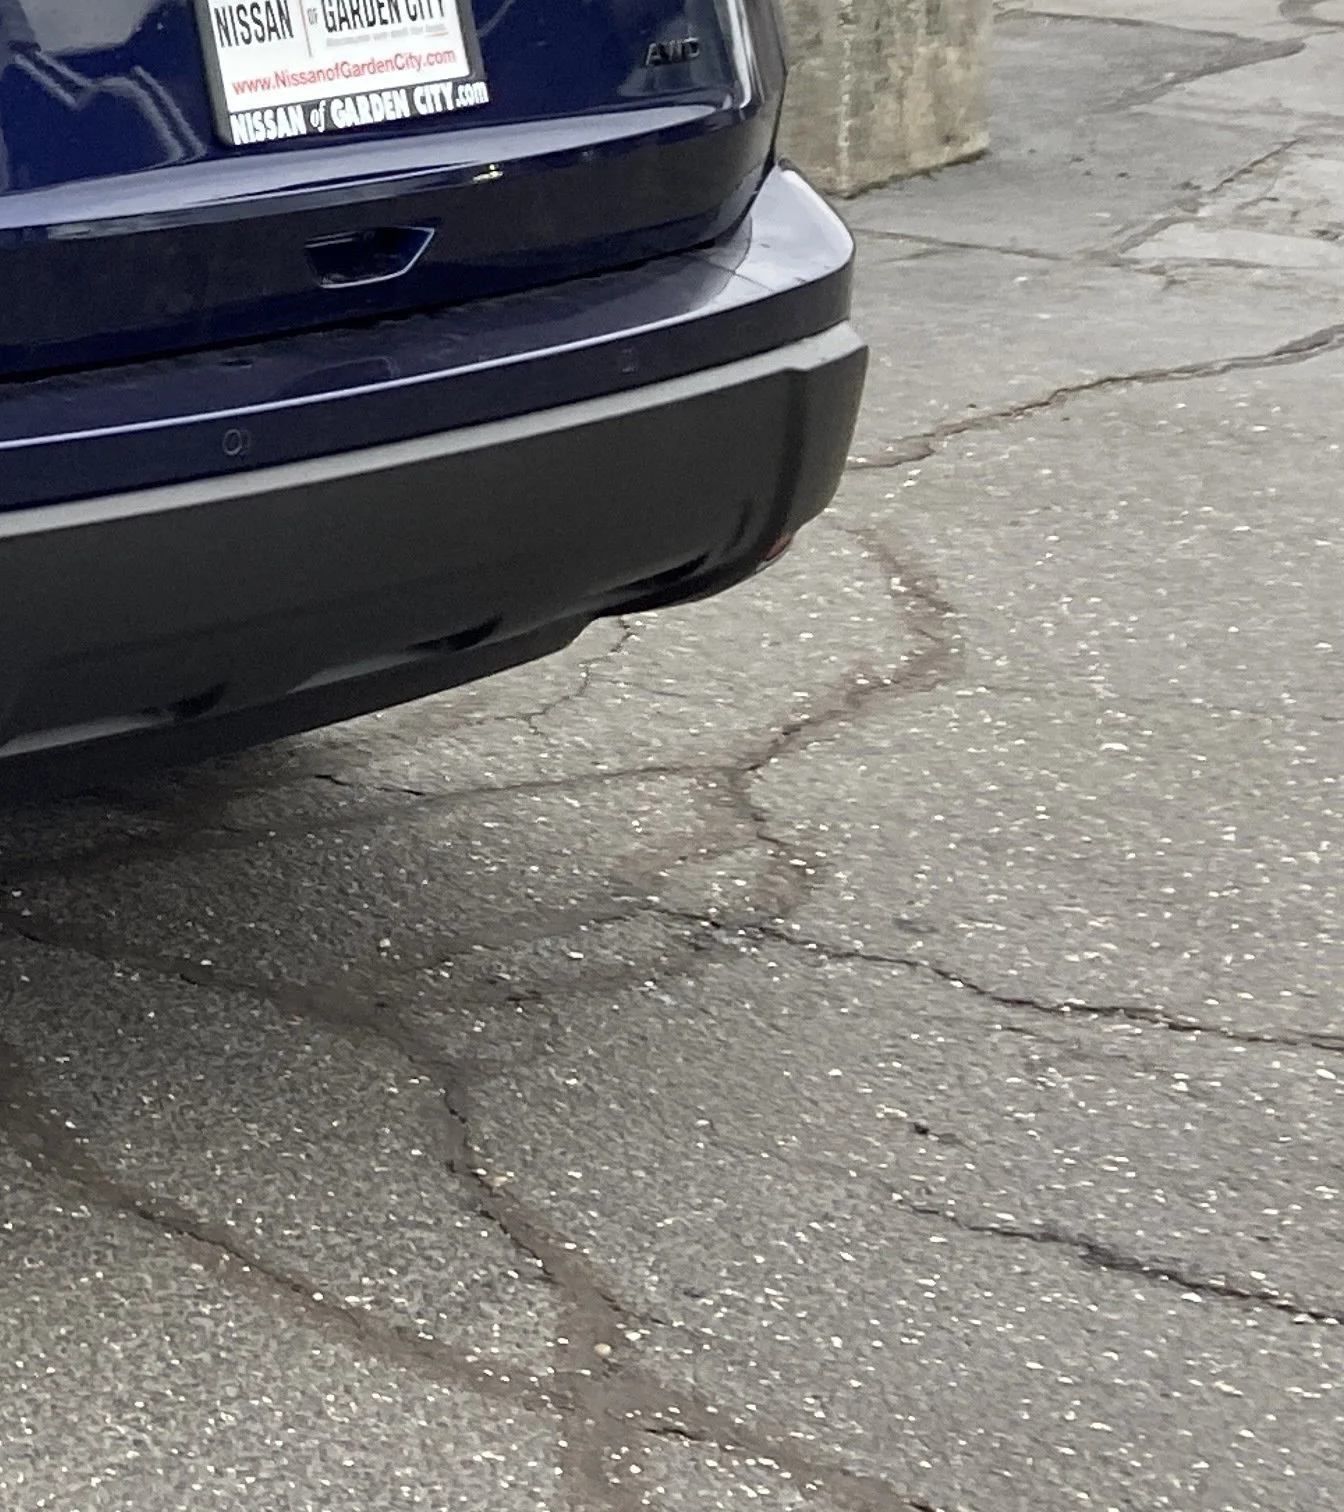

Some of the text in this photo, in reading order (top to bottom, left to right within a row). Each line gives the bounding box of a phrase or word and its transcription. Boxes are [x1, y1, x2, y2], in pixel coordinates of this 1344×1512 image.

[232, 49, 456, 95] www.NissanofGardenCity.com
[229, 82, 489, 146] NISSAN of GARDEN CITY.com
